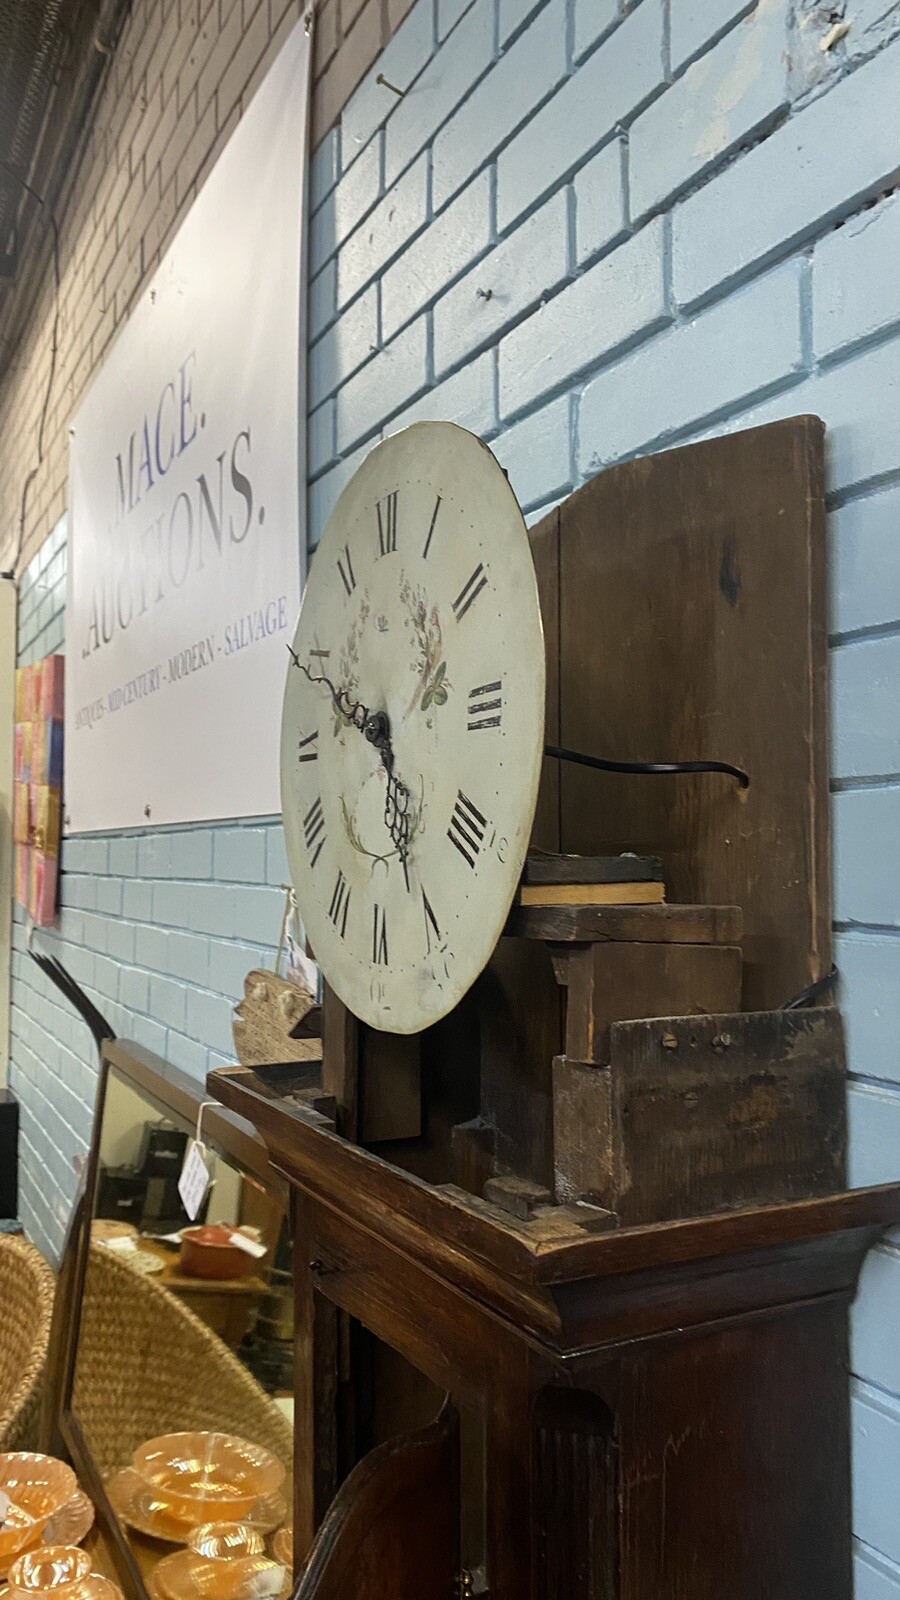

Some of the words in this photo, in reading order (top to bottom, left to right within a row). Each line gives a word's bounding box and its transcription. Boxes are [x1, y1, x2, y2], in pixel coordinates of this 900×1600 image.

[452, 562, 488, 623] II
[168, 635, 215, 683] MODERN
[224, 596, 288, 656] SALVAGE
[467, 680, 502, 730] III
